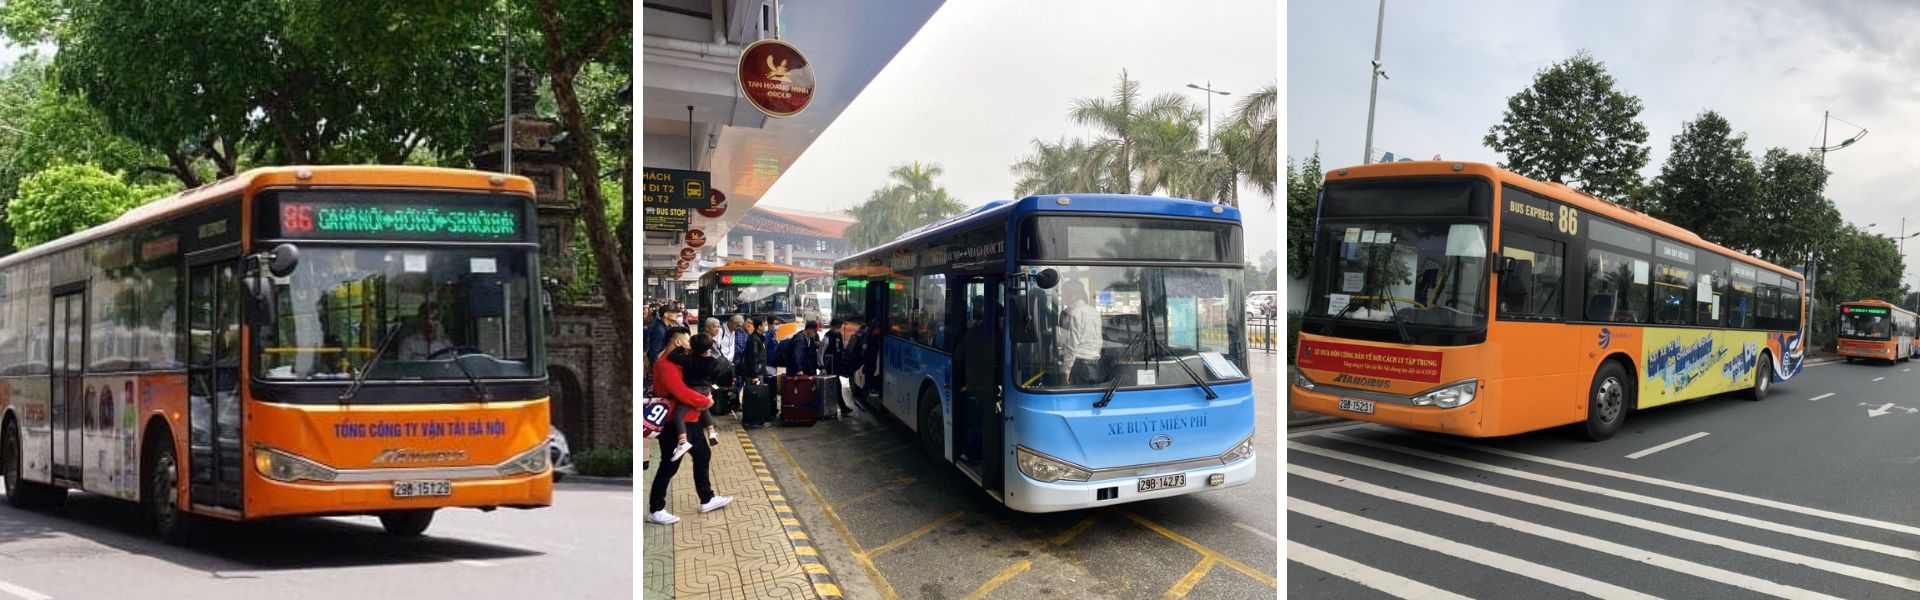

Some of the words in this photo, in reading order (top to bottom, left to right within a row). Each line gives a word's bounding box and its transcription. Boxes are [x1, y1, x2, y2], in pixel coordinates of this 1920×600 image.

[767, 90, 792, 99] GROUP
[662, 184, 675, 193] T2
[656, 195, 669, 203] T2
[656, 207, 669, 216] BUS
[669, 208, 686, 217] STOP
[1510, 200, 1524, 214] BUS
[1525, 204, 1554, 222] EXPRESS
[1558, 204, 1578, 236] 86
[1416, 357, 1438, 367] TRUNG
[646, 404, 668, 425] 91
[334, 417, 366, 438] TỔNG
[368, 420, 401, 438] CÔNG
[404, 422, 417, 437] TY
[420, 419, 445, 439] VẬN
[448, 417, 465, 437] TẢI
[467, 417, 483, 435] HÀ
[485, 418, 505, 436] NỘI
[1108, 423, 1124, 436] XE
[1127, 416, 1157, 434] BUÝT
